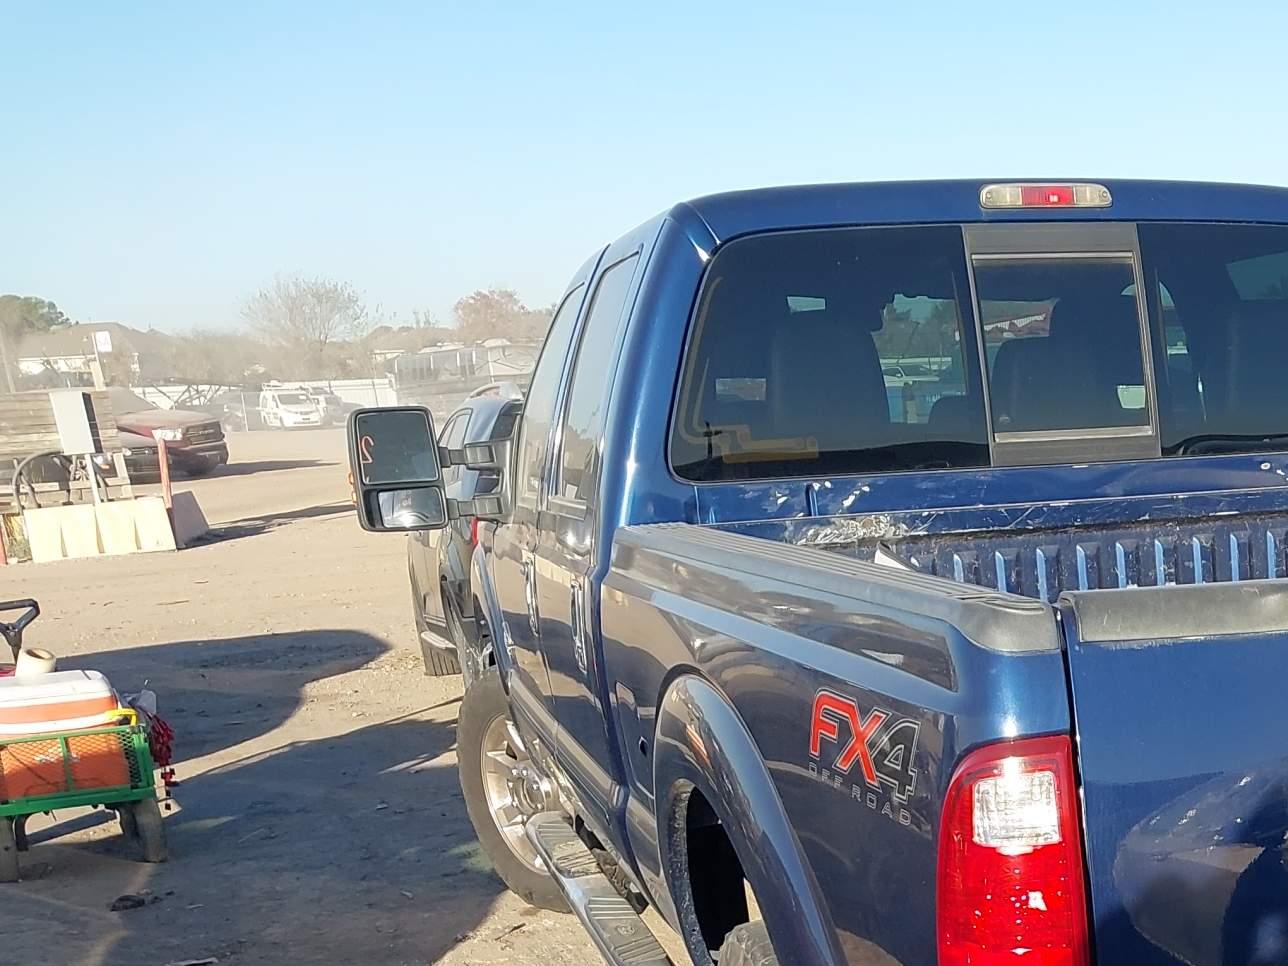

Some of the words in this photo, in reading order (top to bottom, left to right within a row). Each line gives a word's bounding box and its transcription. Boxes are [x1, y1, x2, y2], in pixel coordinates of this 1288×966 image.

[808, 687, 921, 804] FX4
[808, 761, 844, 789] OFF
[851, 784, 912, 826] ROAD
